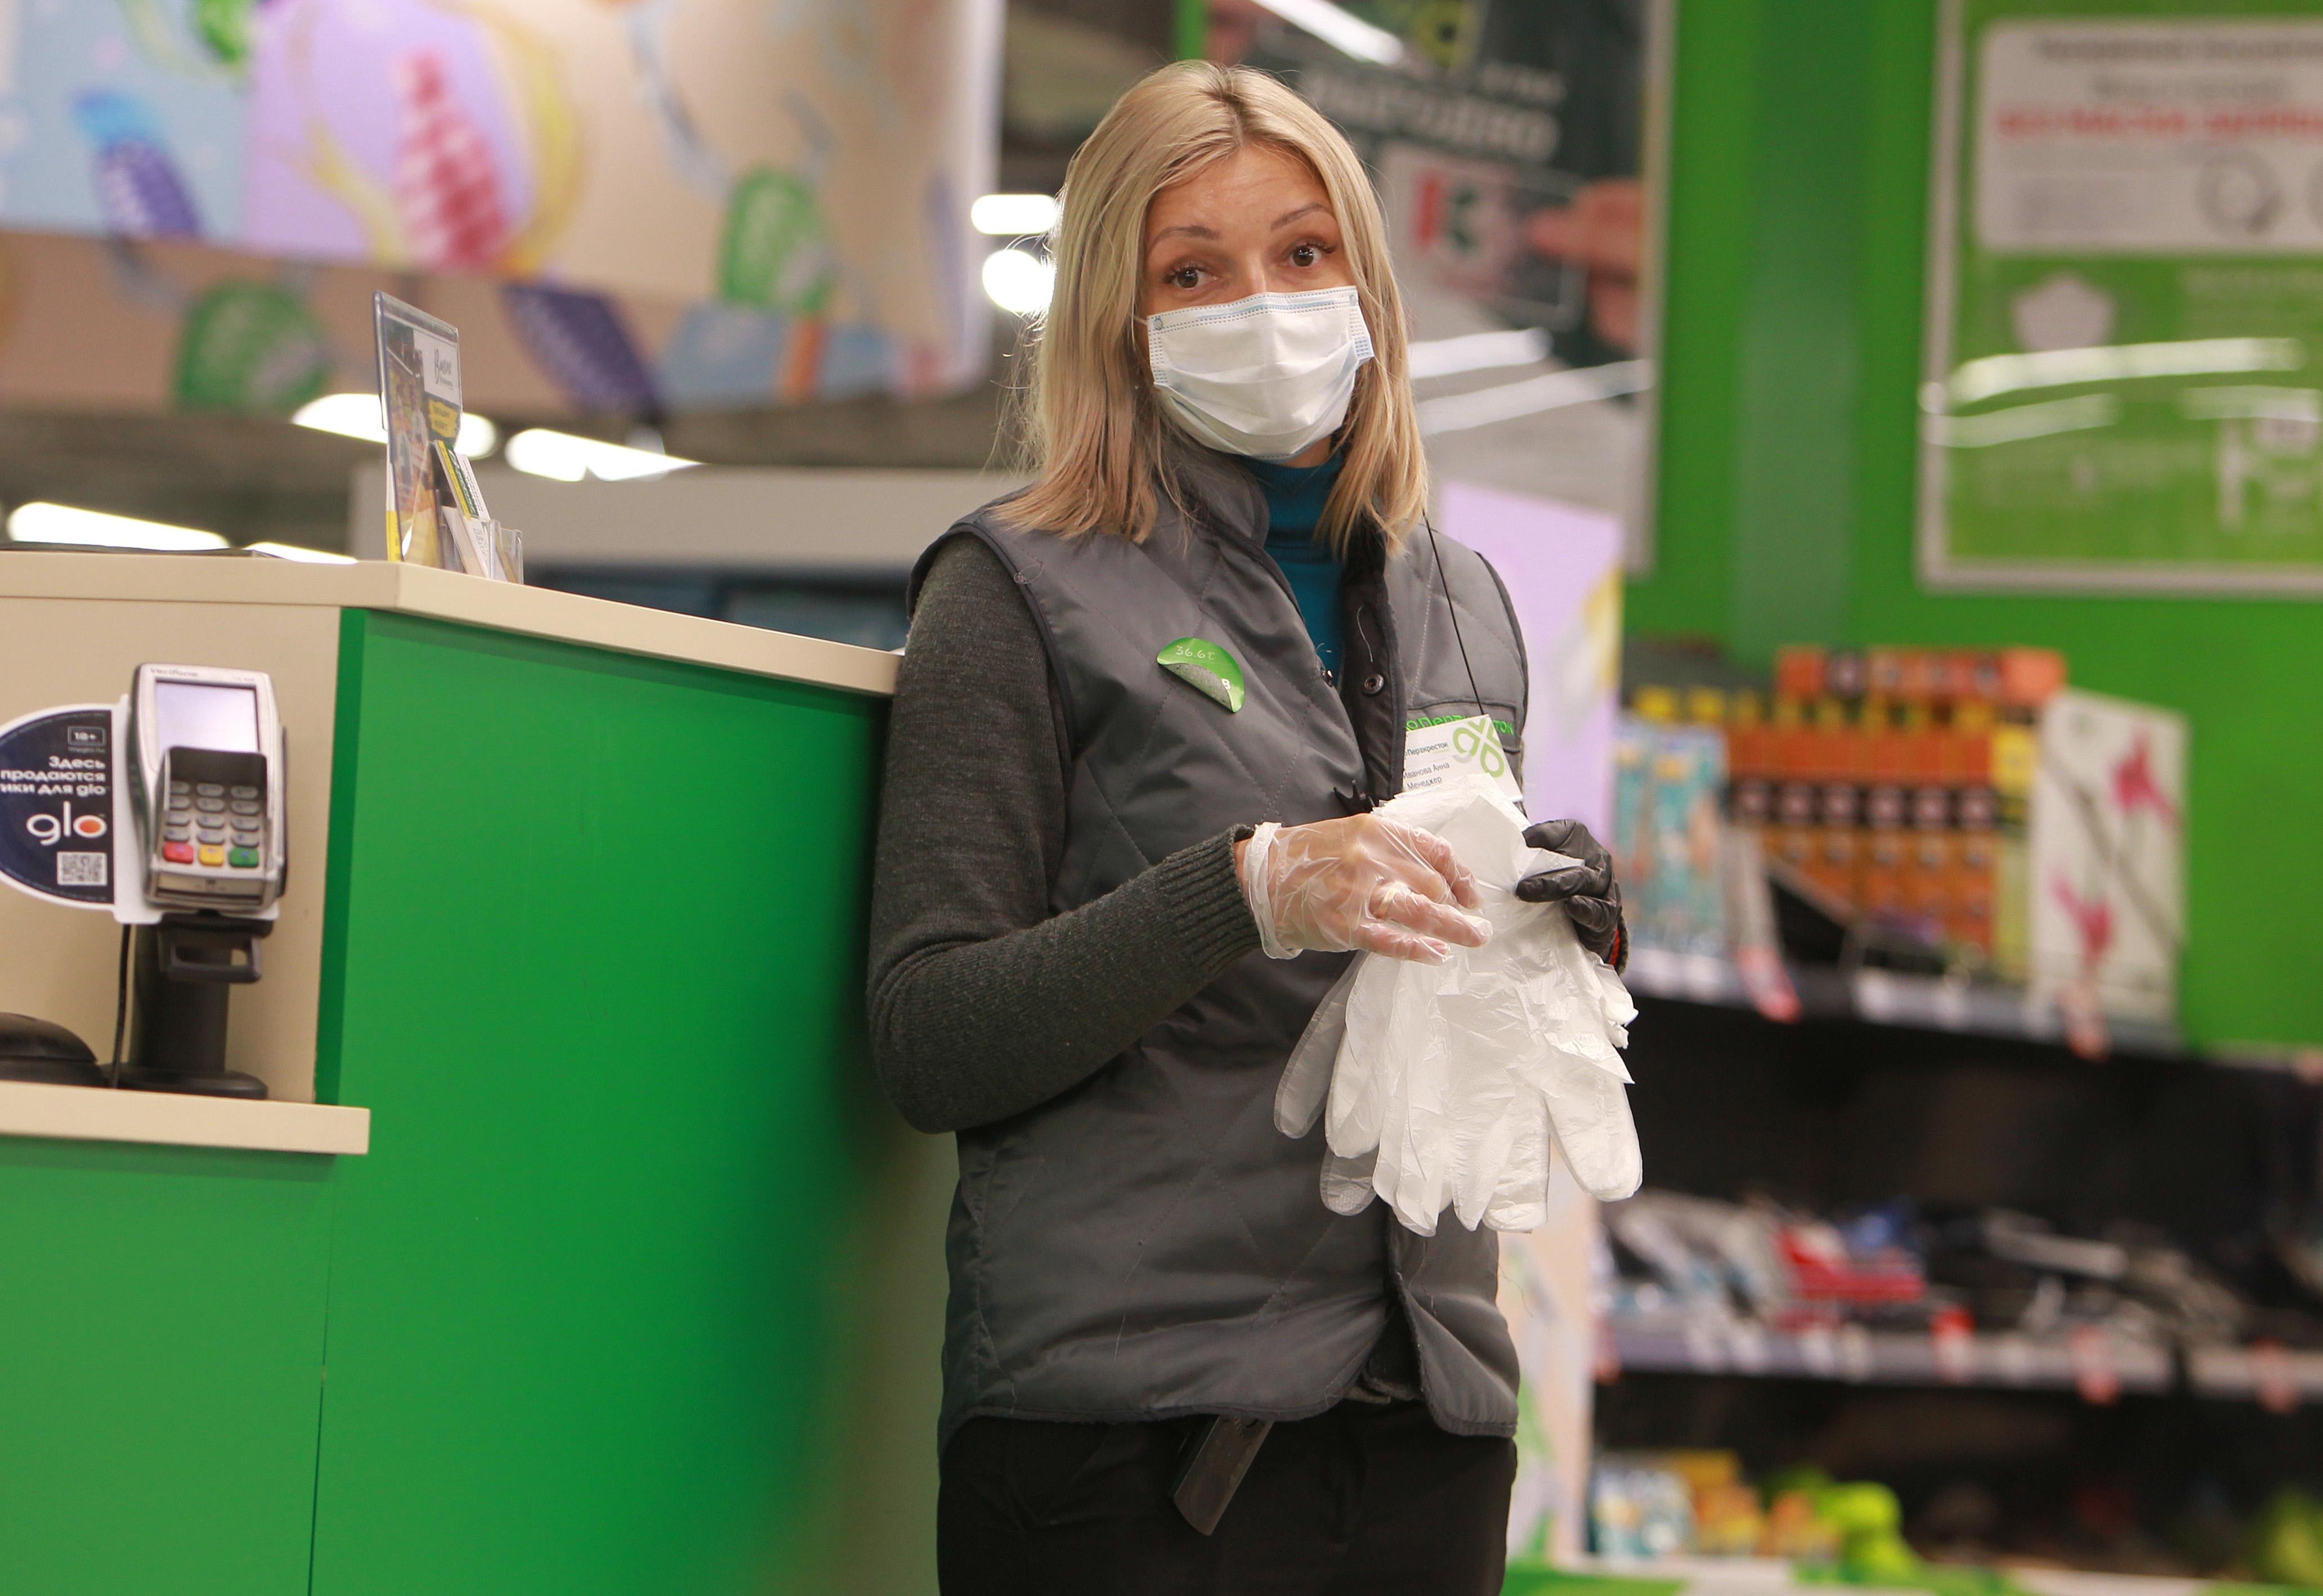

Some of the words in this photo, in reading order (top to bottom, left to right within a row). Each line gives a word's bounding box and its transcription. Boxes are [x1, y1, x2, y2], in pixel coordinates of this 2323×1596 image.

[48, 755, 106, 770] Здесь
[1433, 763, 1450, 772] Анна
[0, 769, 106, 783] продаются
[1407, 776, 1442, 790] Менеджер
[37, 784, 74, 796] для
[76, 783, 107, 798] glo
[26, 801, 106, 845] glo
